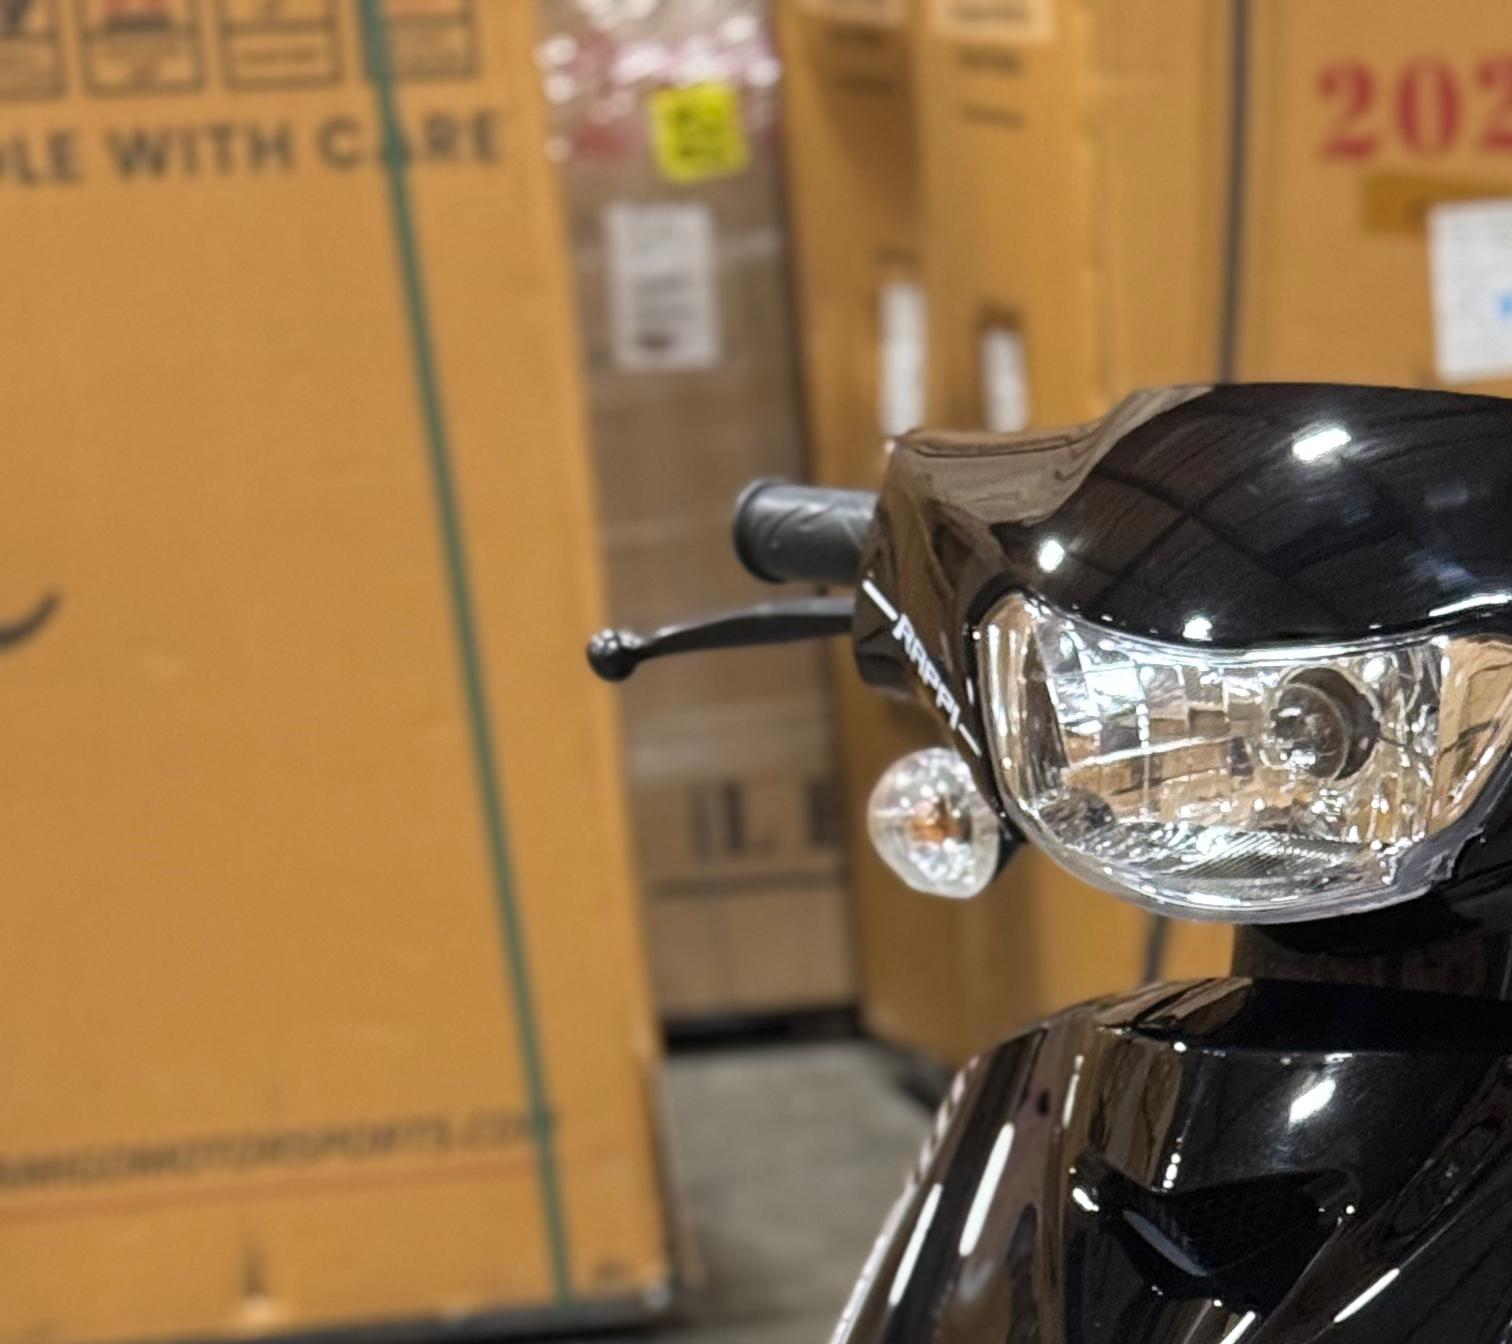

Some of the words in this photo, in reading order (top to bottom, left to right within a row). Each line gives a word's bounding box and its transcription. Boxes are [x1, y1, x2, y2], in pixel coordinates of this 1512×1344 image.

[106, 120, 295, 181] WITH
[316, 109, 502, 170] CRE
[892, 614, 960, 730] RAPPI
